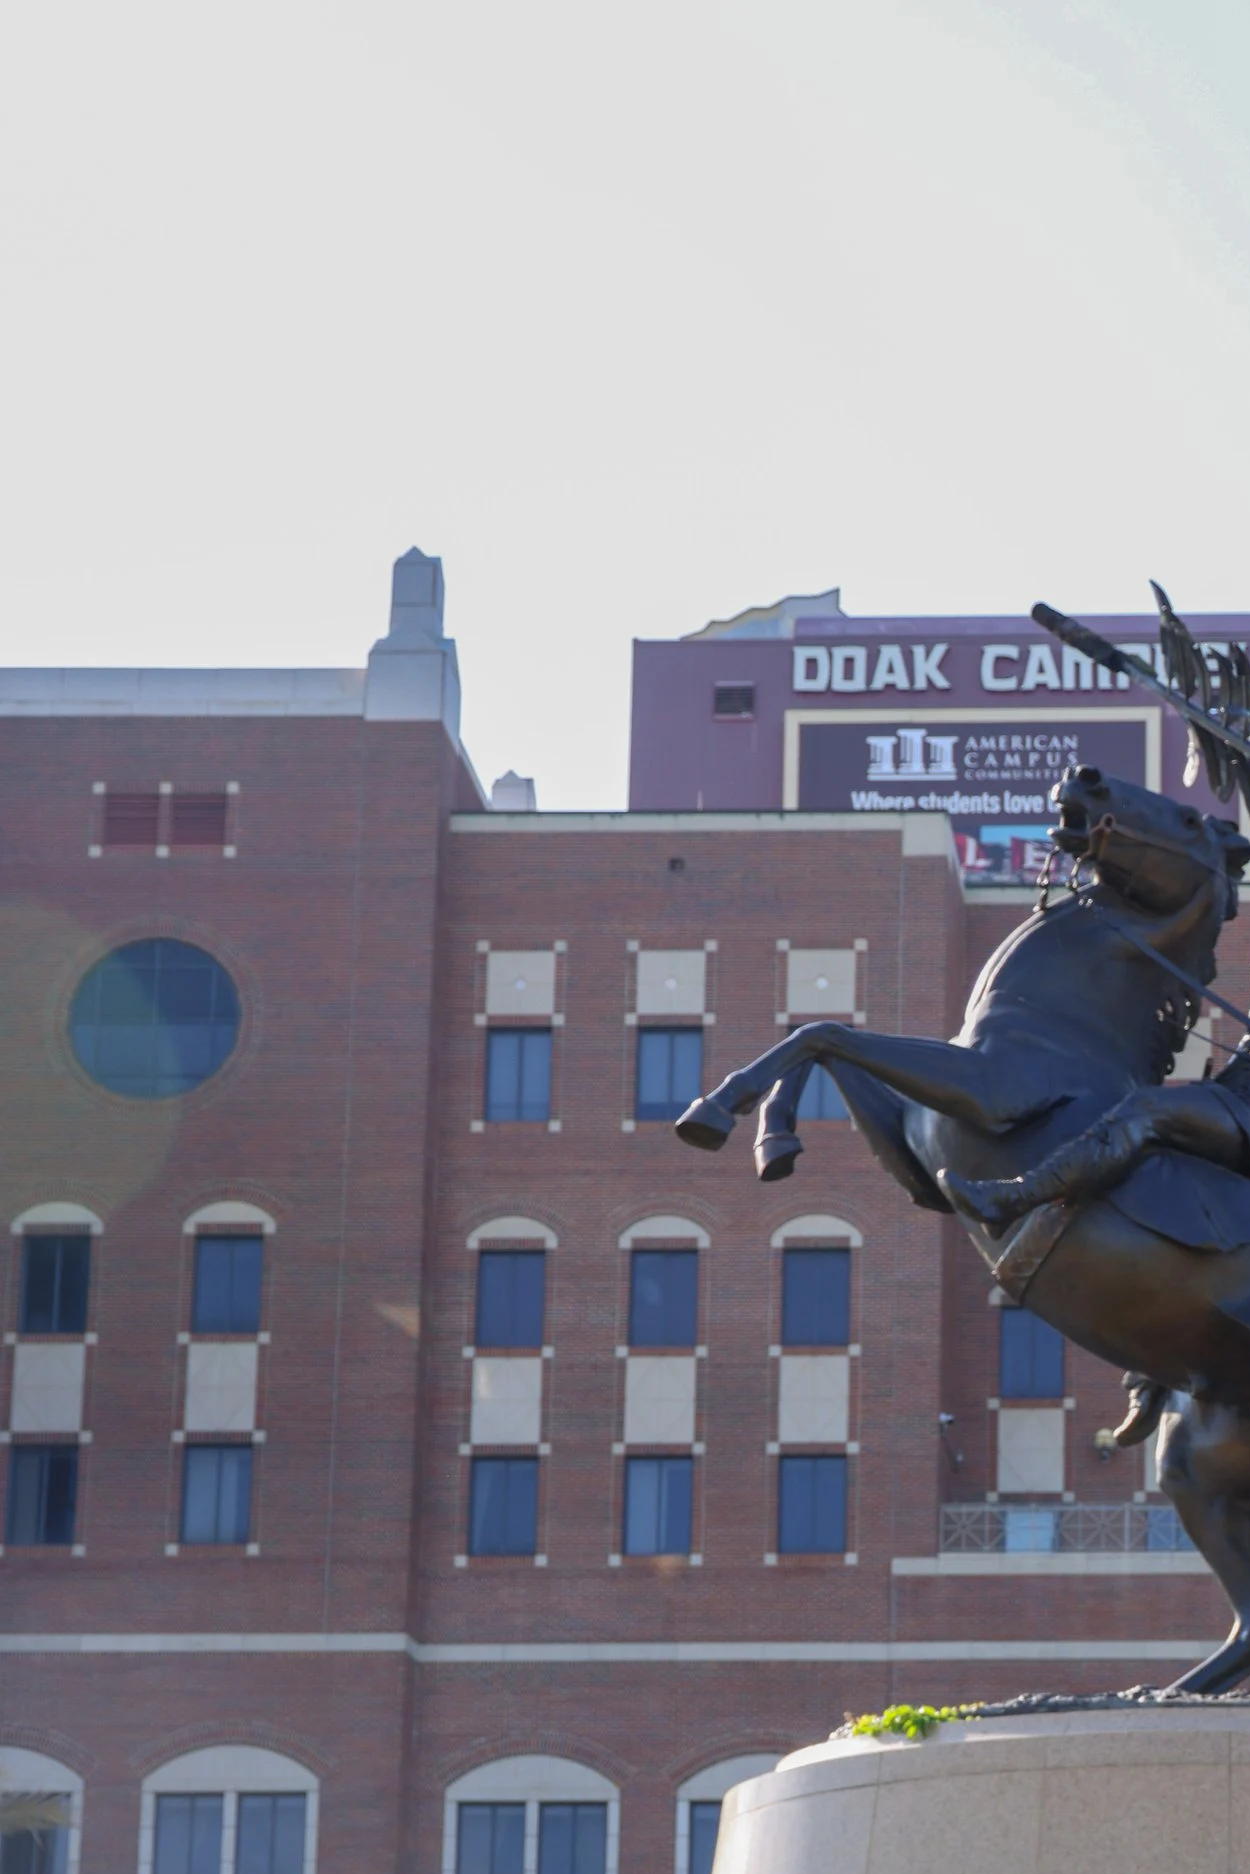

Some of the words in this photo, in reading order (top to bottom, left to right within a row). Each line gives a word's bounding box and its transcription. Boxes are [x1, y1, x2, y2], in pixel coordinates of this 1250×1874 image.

[793, 642, 951, 692] DOAK
[964, 734, 1079, 751] AMERICAN
[963, 751, 1078, 768] CAMPUS
[964, 769, 1063, 780] COMMUNITI
[850, 790, 916, 811] Where
[918, 789, 1001, 815] students
[1003, 789, 1045, 815] love
